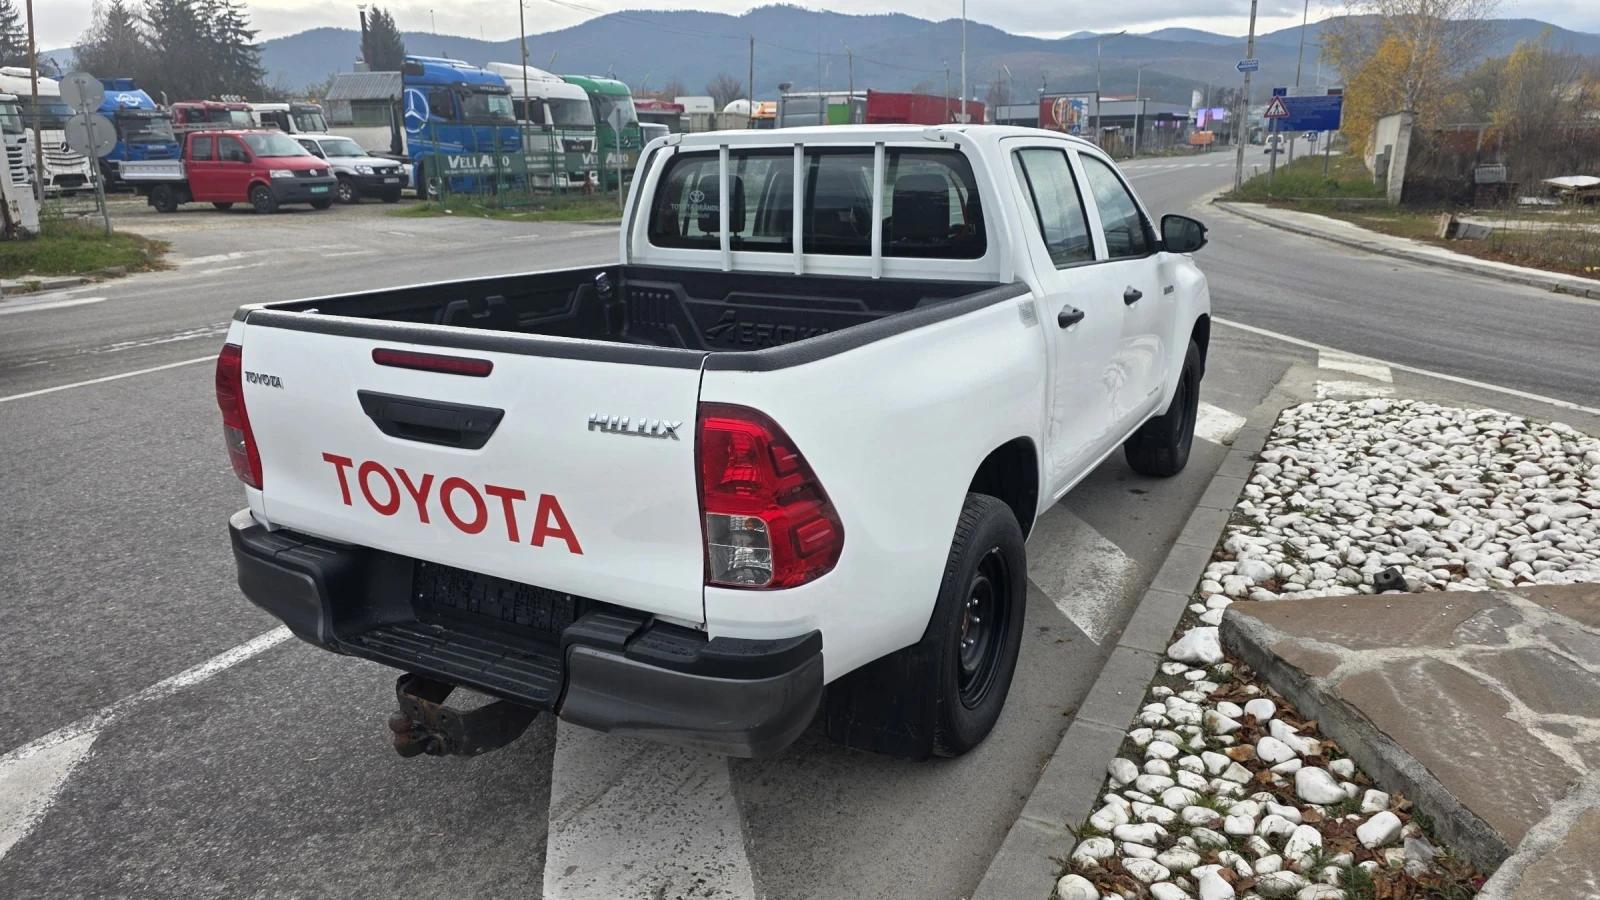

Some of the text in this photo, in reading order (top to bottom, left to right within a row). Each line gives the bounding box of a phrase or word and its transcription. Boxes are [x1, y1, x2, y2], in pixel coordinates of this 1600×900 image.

[447, 155, 477, 168] VELI
[480, 154, 510, 168] AUO
[581, 152, 599, 165] VEL
[244, 370, 285, 390] TOYOTA
[587, 412, 683, 441] HILUX
[322, 452, 583, 555] TOYOTA
